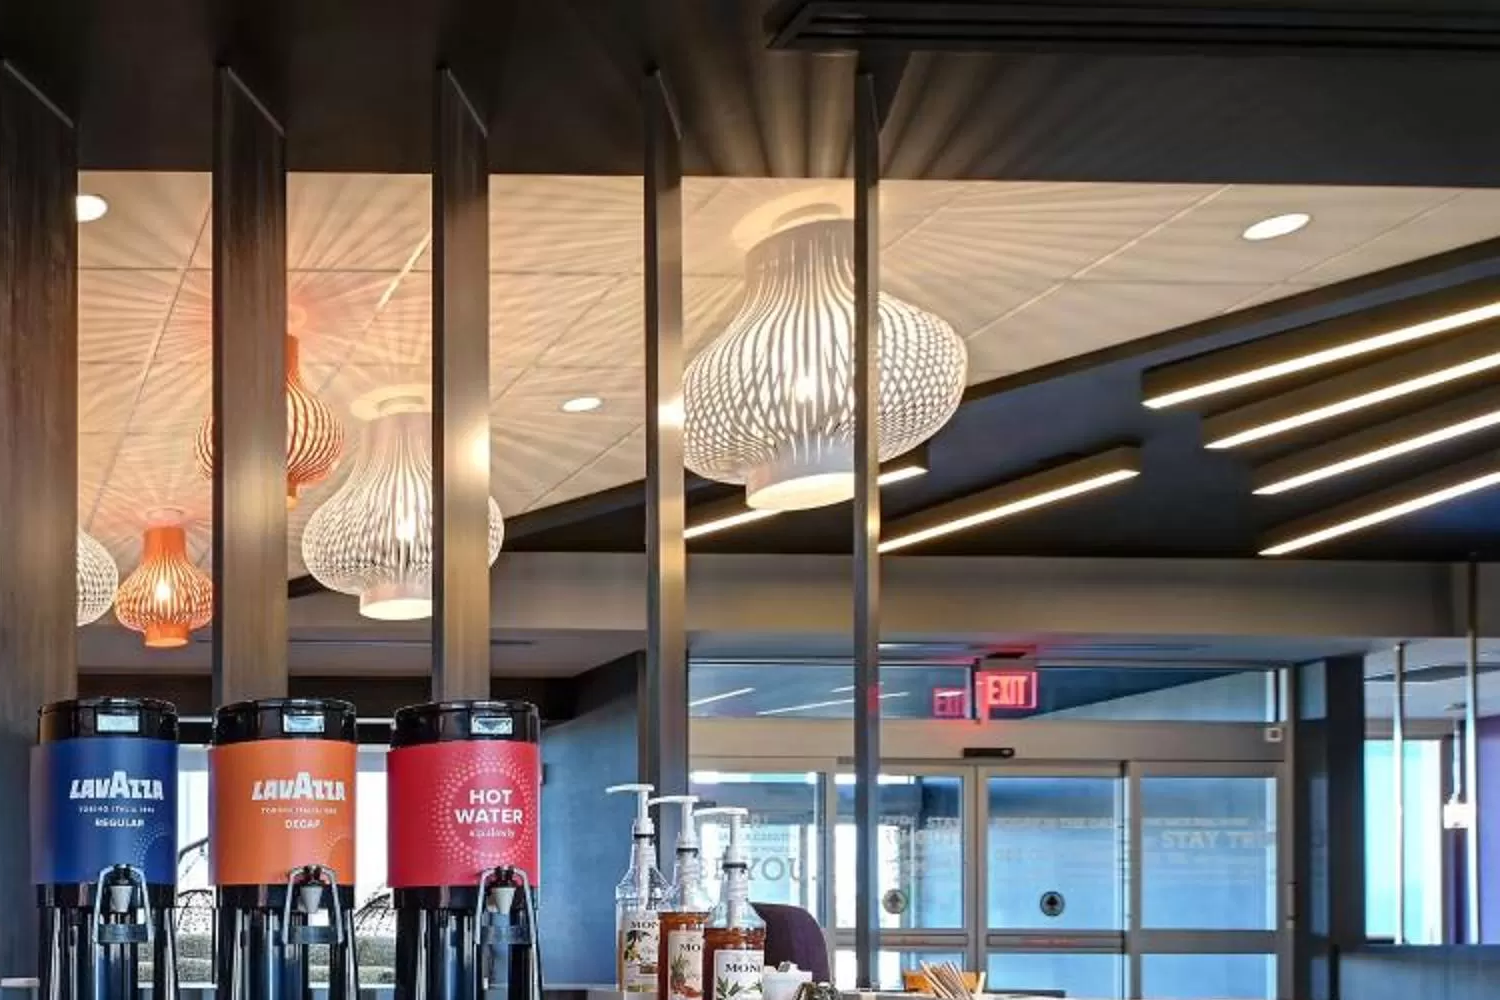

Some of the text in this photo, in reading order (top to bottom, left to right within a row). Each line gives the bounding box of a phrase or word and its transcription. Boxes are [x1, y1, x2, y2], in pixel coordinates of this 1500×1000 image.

[987, 675, 1028, 705] EXIT
[69, 770, 164, 800] LAVAZZA
[251, 772, 346, 801] LAVAZZA
[469, 789, 513, 805] HOT
[95, 818, 145, 828] REGULAR
[284, 819, 322, 829] DECAF
[454, 808, 523, 825] WATER
[1161, 830, 1220, 849] STAY
